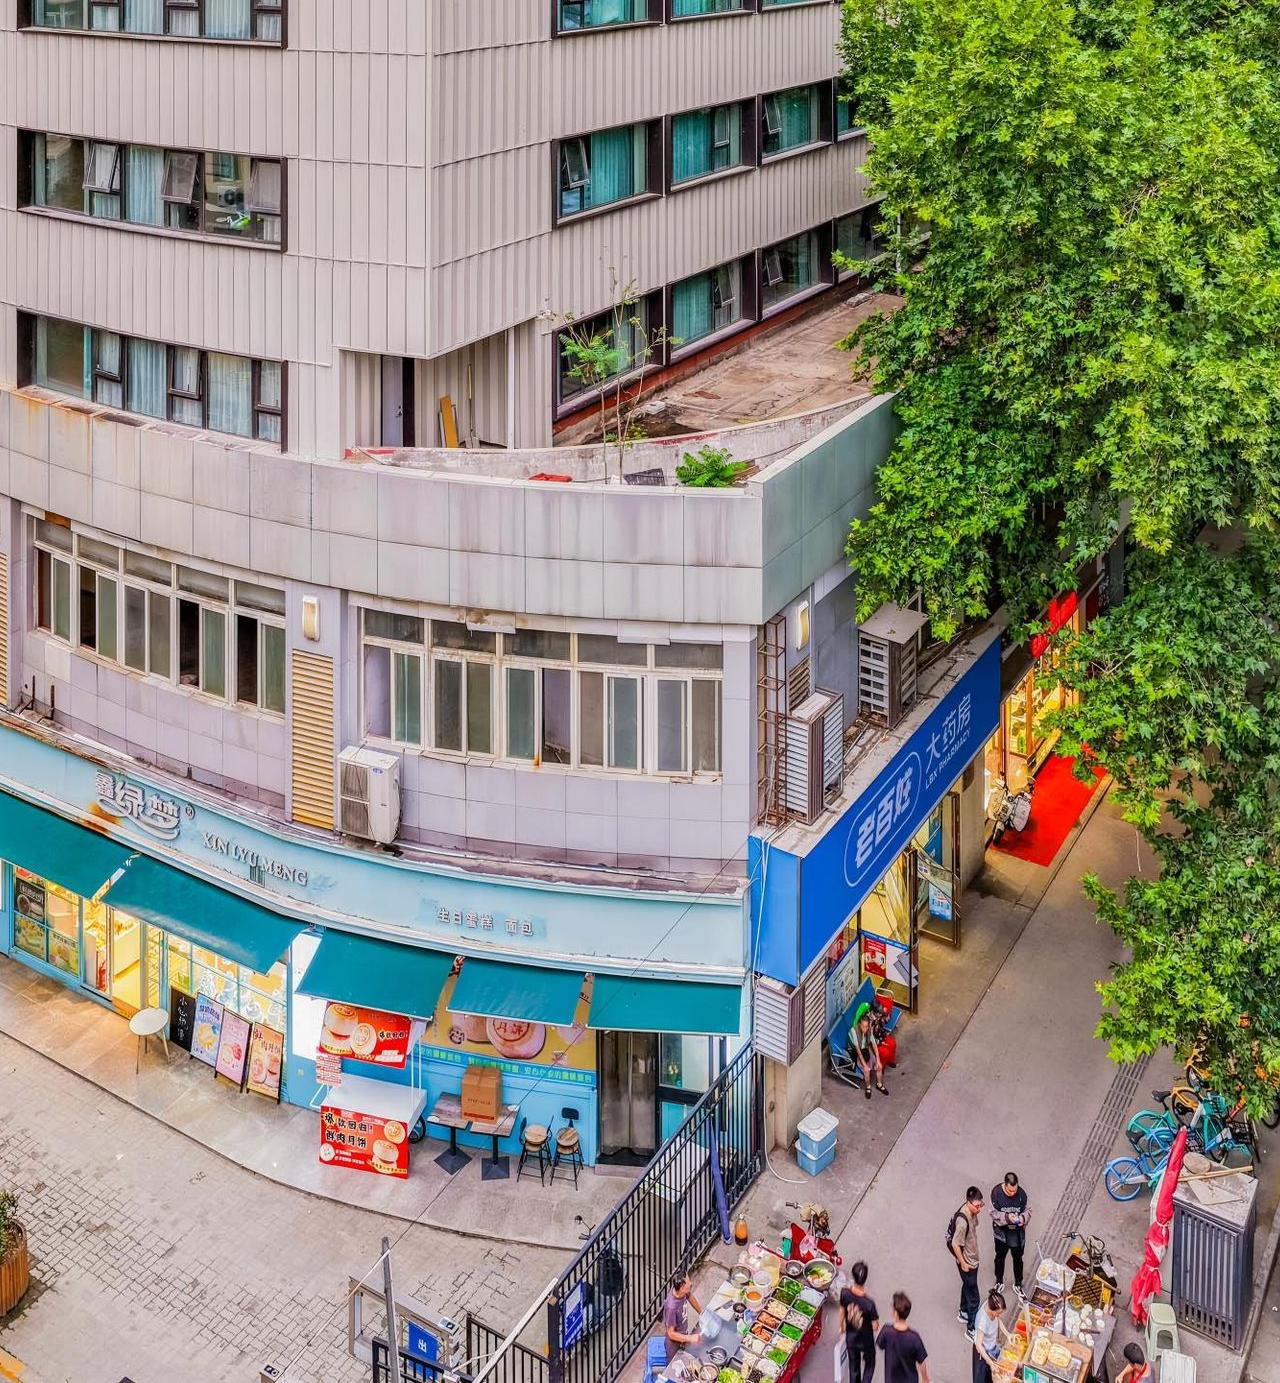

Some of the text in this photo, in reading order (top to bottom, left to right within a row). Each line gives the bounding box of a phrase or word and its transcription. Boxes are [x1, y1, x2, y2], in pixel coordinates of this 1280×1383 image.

[925, 693, 972, 774] 大药房
[938, 728, 971, 771] PHARMACY
[855, 766, 914, 869] 老百姓
[201, 830, 309, 887] XIN LYU MENG
[438, 906, 534, 936] 生日蛋糕 面包
